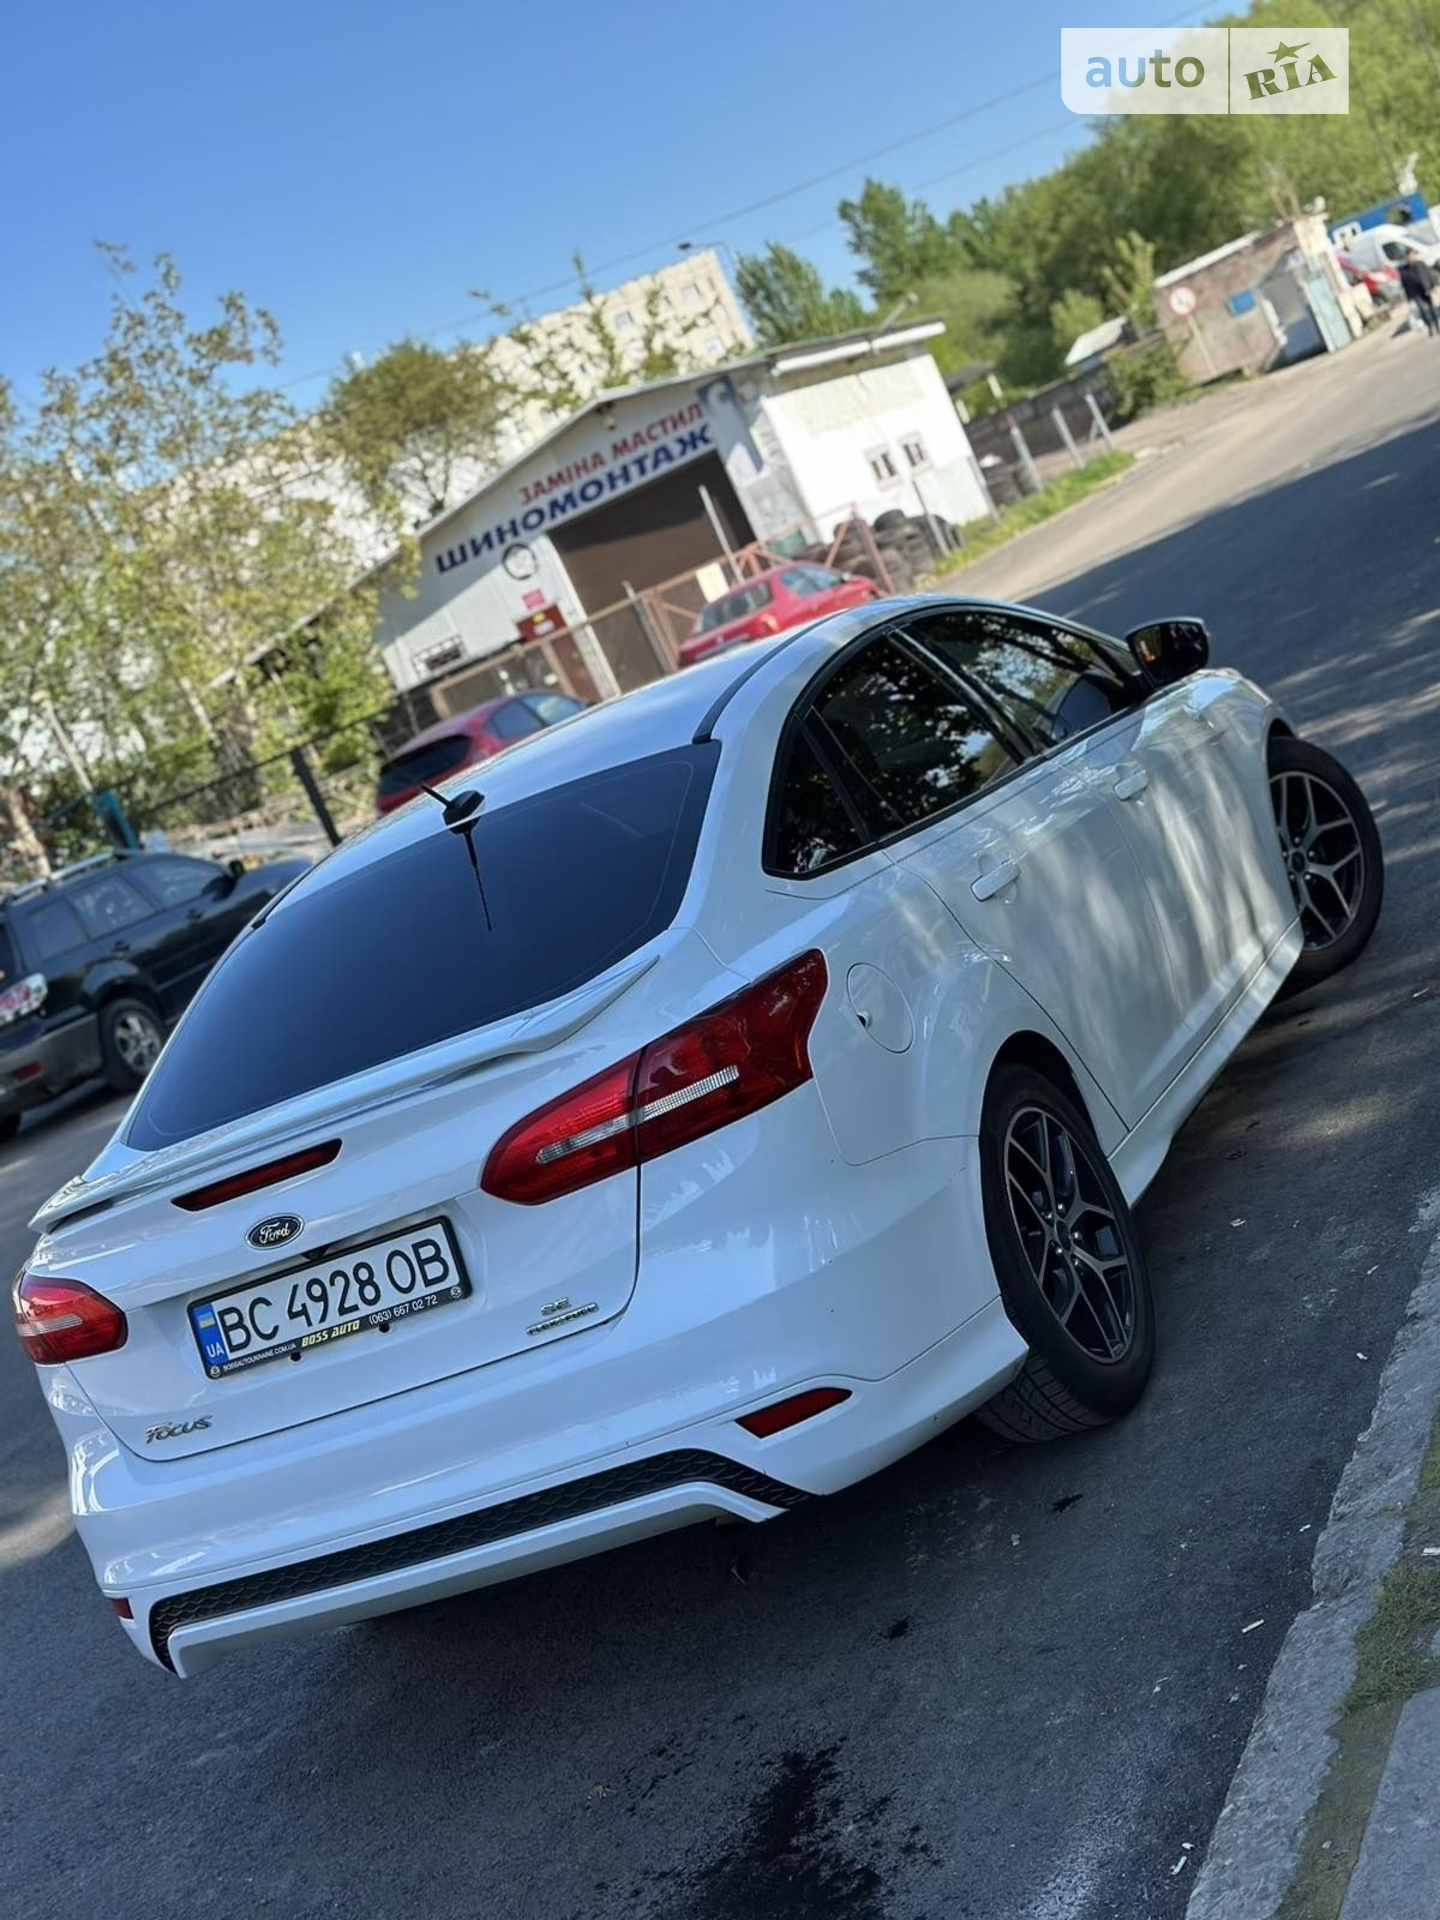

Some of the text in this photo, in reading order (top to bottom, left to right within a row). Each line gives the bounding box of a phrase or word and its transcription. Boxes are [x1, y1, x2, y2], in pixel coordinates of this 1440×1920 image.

[519, 403, 705, 505] ЗАМІНА МАСТИЛ
[435, 423, 712, 575] ШИНОМОНТАЖ
[259, 1222, 290, 1244] Ford
[217, 1238, 450, 1353] BC 4928 OB
[301, 1330, 329, 1348] BOSS
[331, 1320, 360, 1338] AUTO
[369, 1310, 392, 1325] (063)
[393, 1303, 409, 1317] 667
[412, 1299, 425, 1311] 02
[425, 1294, 438, 1307] 72
[205, 1341, 225, 1358] UA
